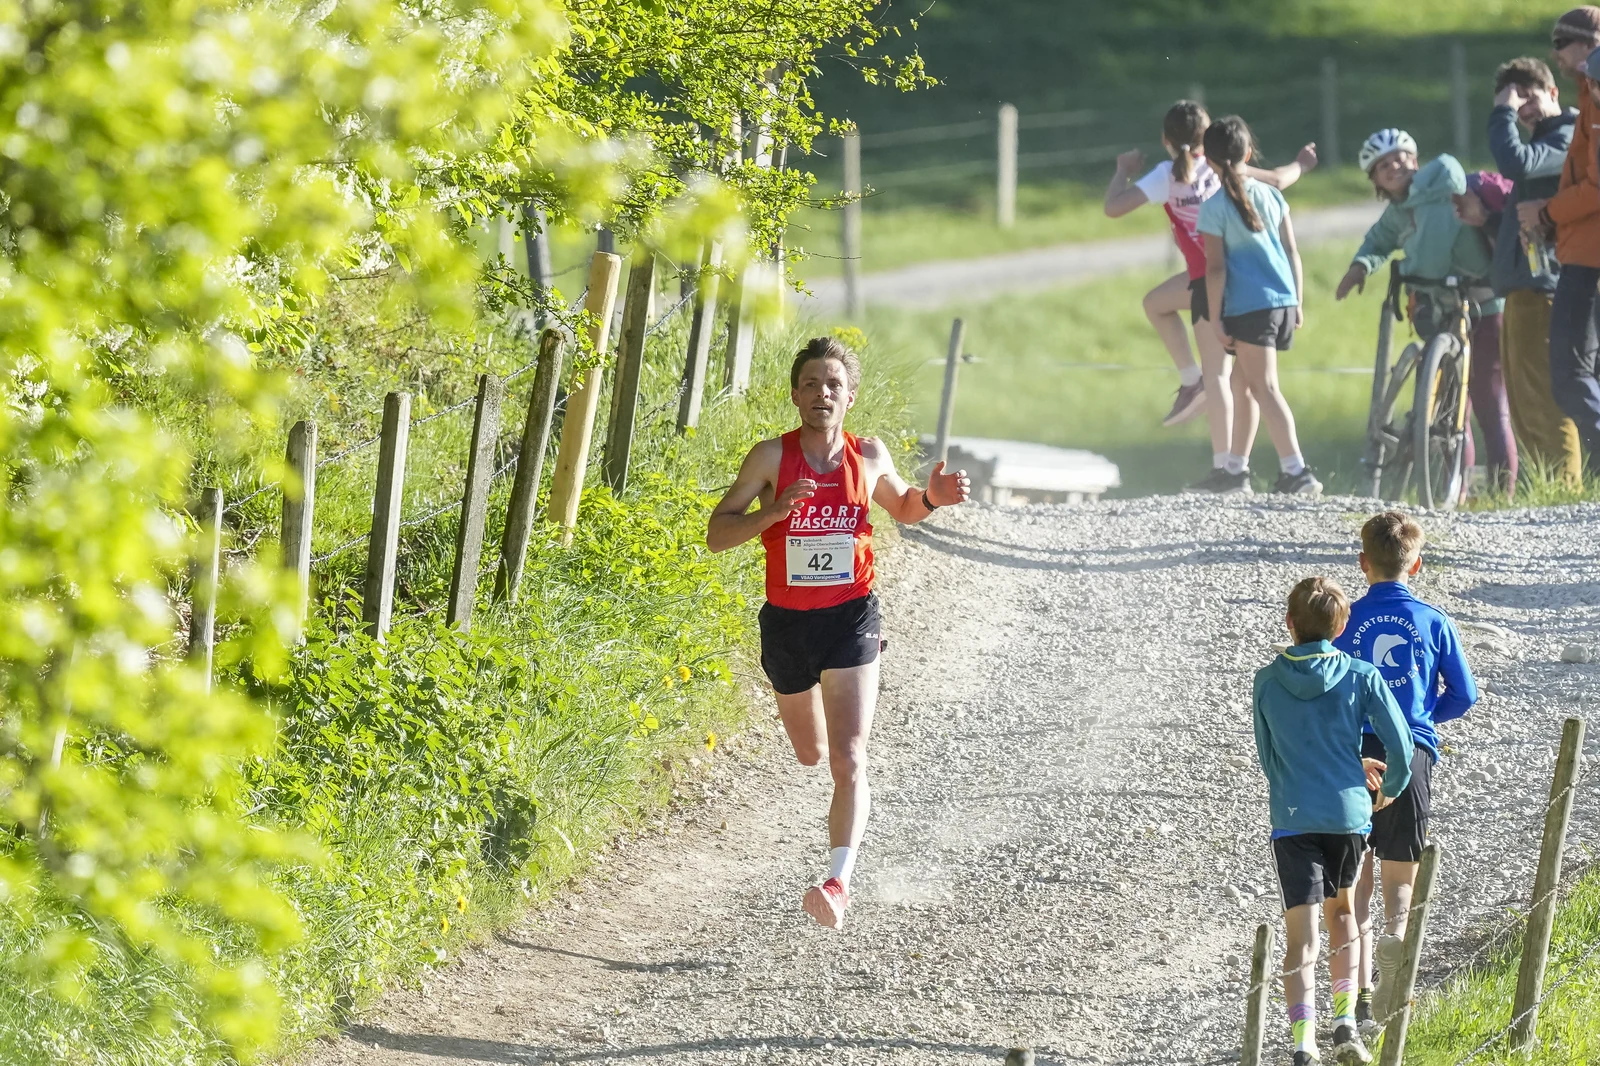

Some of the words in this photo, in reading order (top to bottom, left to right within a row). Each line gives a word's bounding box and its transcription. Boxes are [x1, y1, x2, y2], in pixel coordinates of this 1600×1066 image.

[792, 505, 861, 517] SPORT
[789, 517, 858, 529] HASCHKO
[807, 552, 833, 571] 42
[1352, 615, 1422, 645] SPORTGEMEINDE
[1352, 649, 1361, 658] 18
